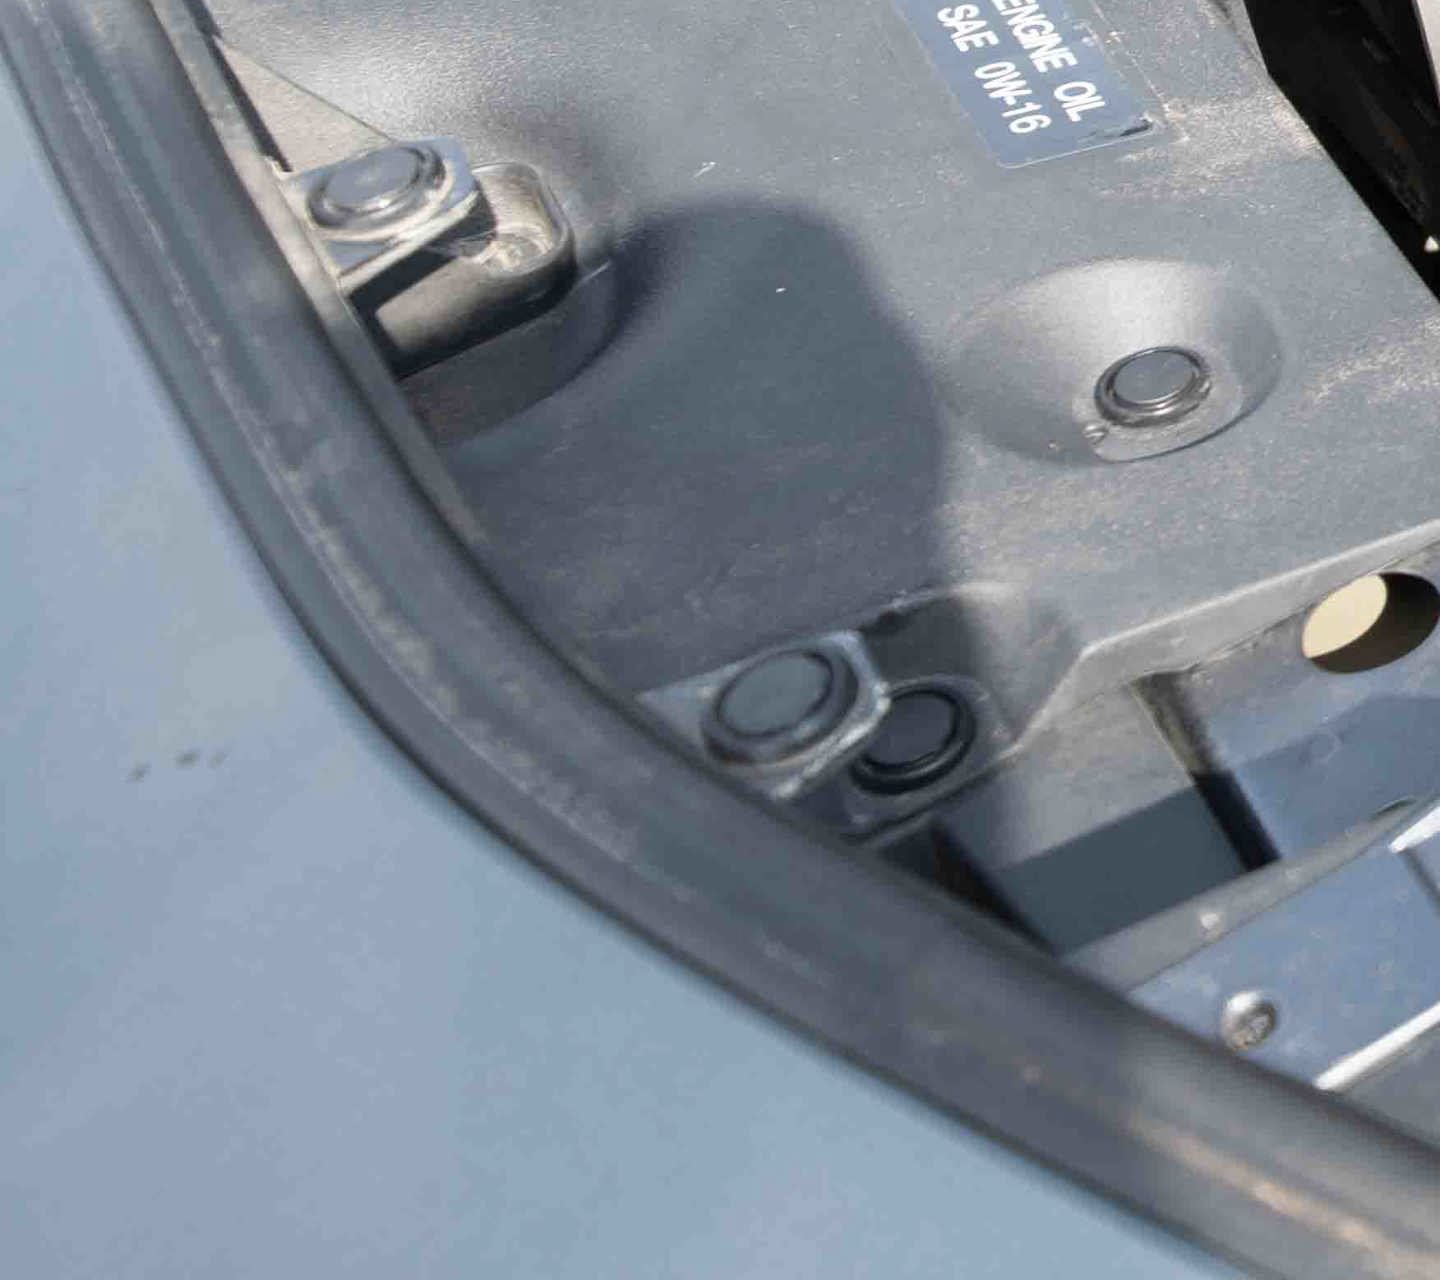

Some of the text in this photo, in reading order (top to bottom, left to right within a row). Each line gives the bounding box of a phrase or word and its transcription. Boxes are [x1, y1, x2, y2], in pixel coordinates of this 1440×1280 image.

[937, 4, 1052, 134] SAE 0W-16
[1053, 81, 1105, 122] OIL
